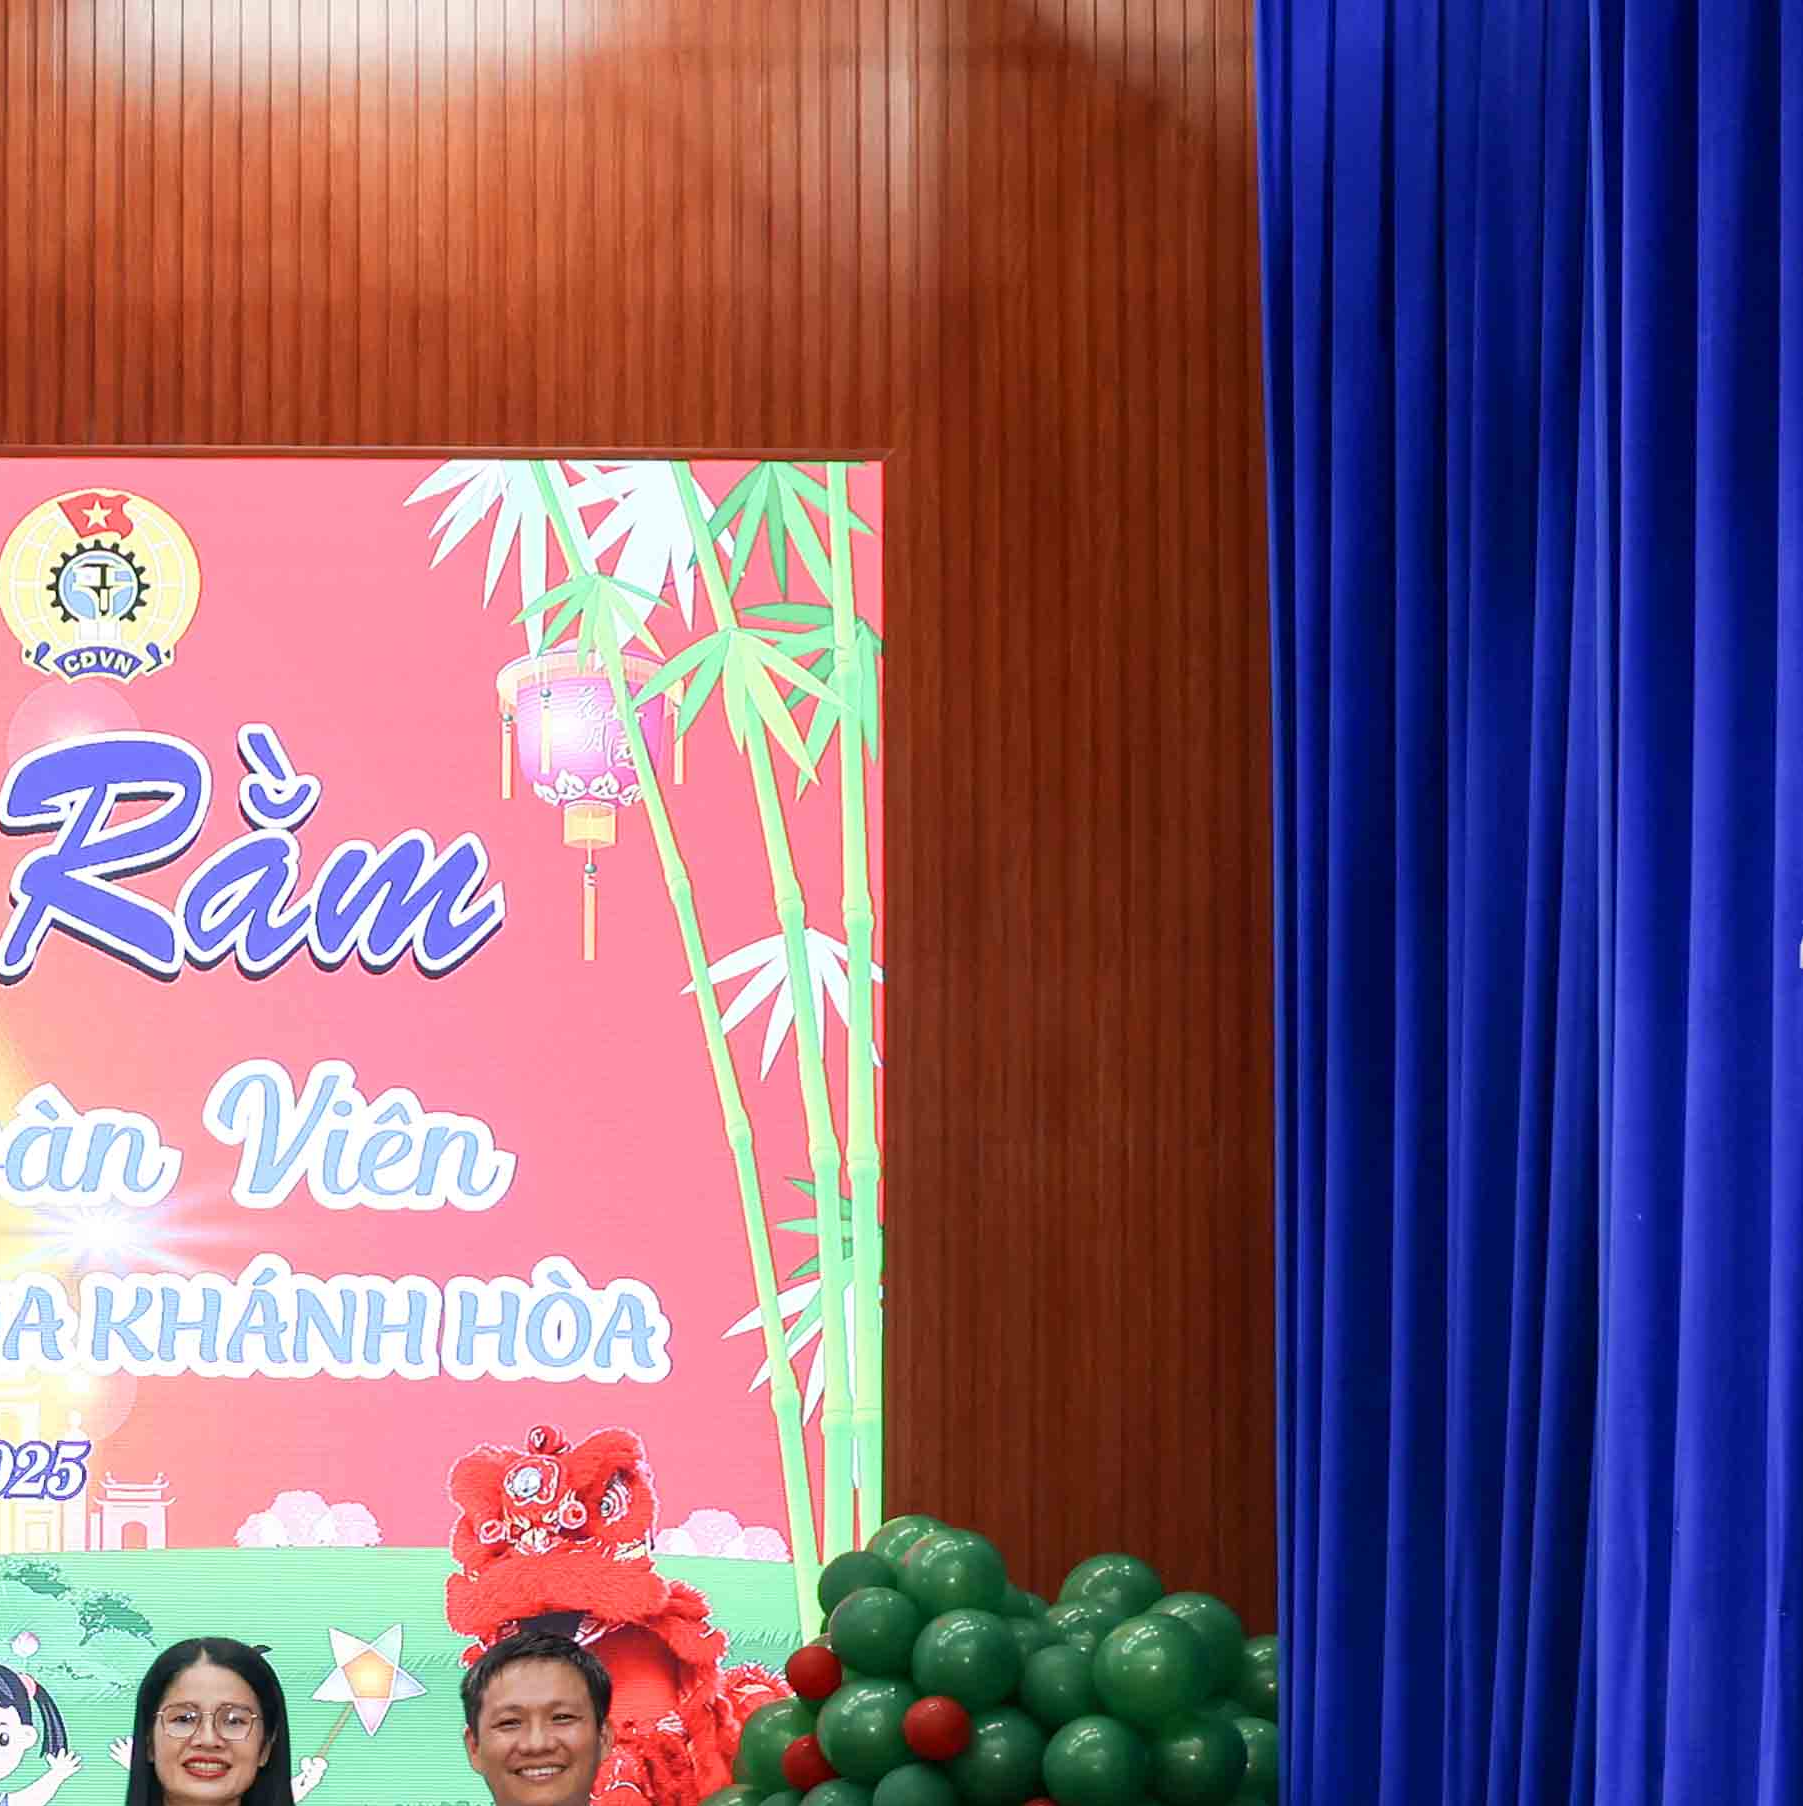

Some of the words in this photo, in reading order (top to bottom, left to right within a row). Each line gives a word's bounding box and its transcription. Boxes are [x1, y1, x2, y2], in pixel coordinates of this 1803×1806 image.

[0, 728, 503, 972] Rằm
[211, 1070, 509, 1200] Viên
[89, 1266, 430, 1367] KHÁNH
[452, 1270, 659, 1372] HÒA
